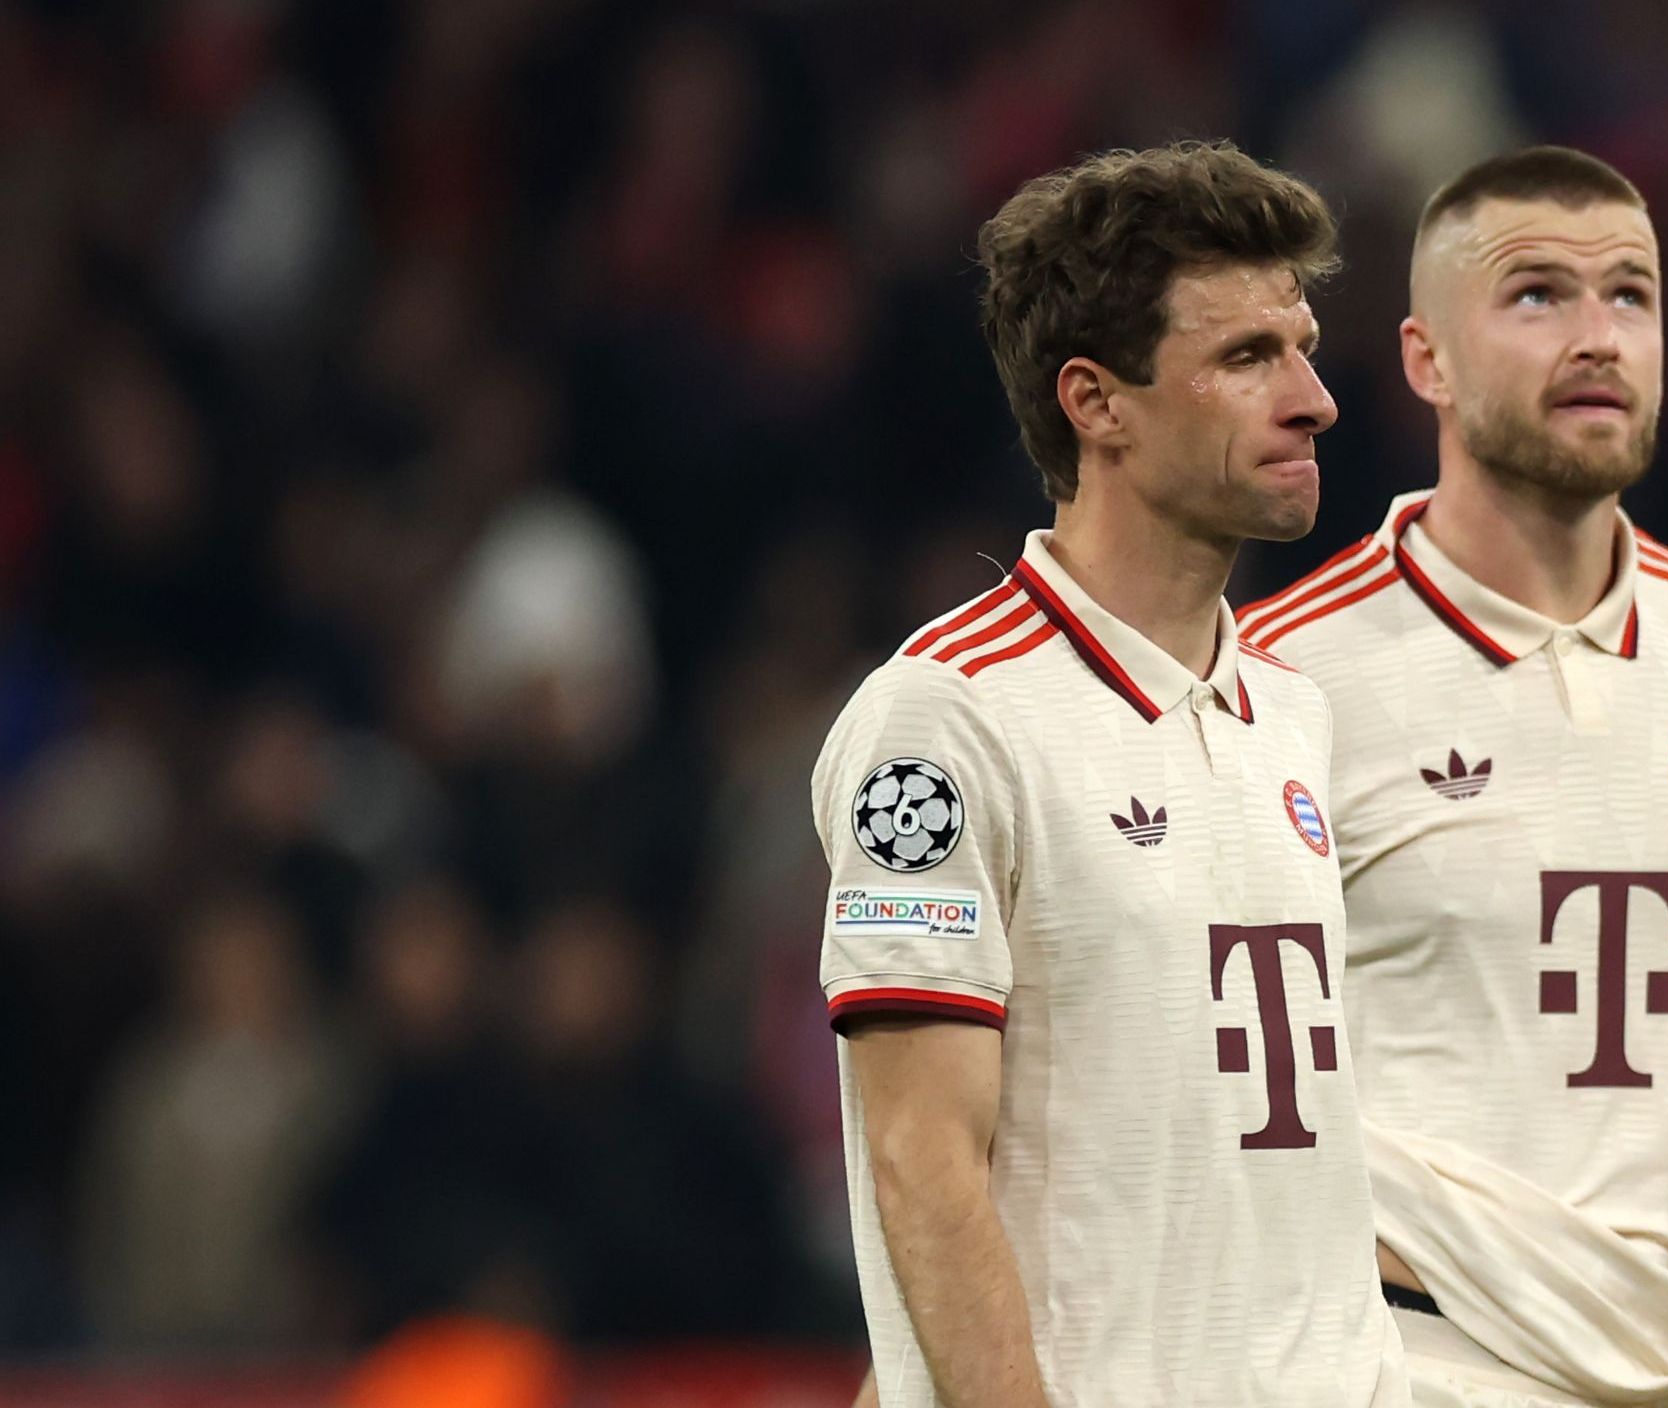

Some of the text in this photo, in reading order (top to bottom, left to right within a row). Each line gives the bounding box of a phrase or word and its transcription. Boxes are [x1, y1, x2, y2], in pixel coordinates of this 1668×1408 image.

[893, 794, 920, 835] 6
[836, 890, 867, 901] UEFA
[929, 923, 975, 935] for children
[1208, 923, 1338, 1150] T
